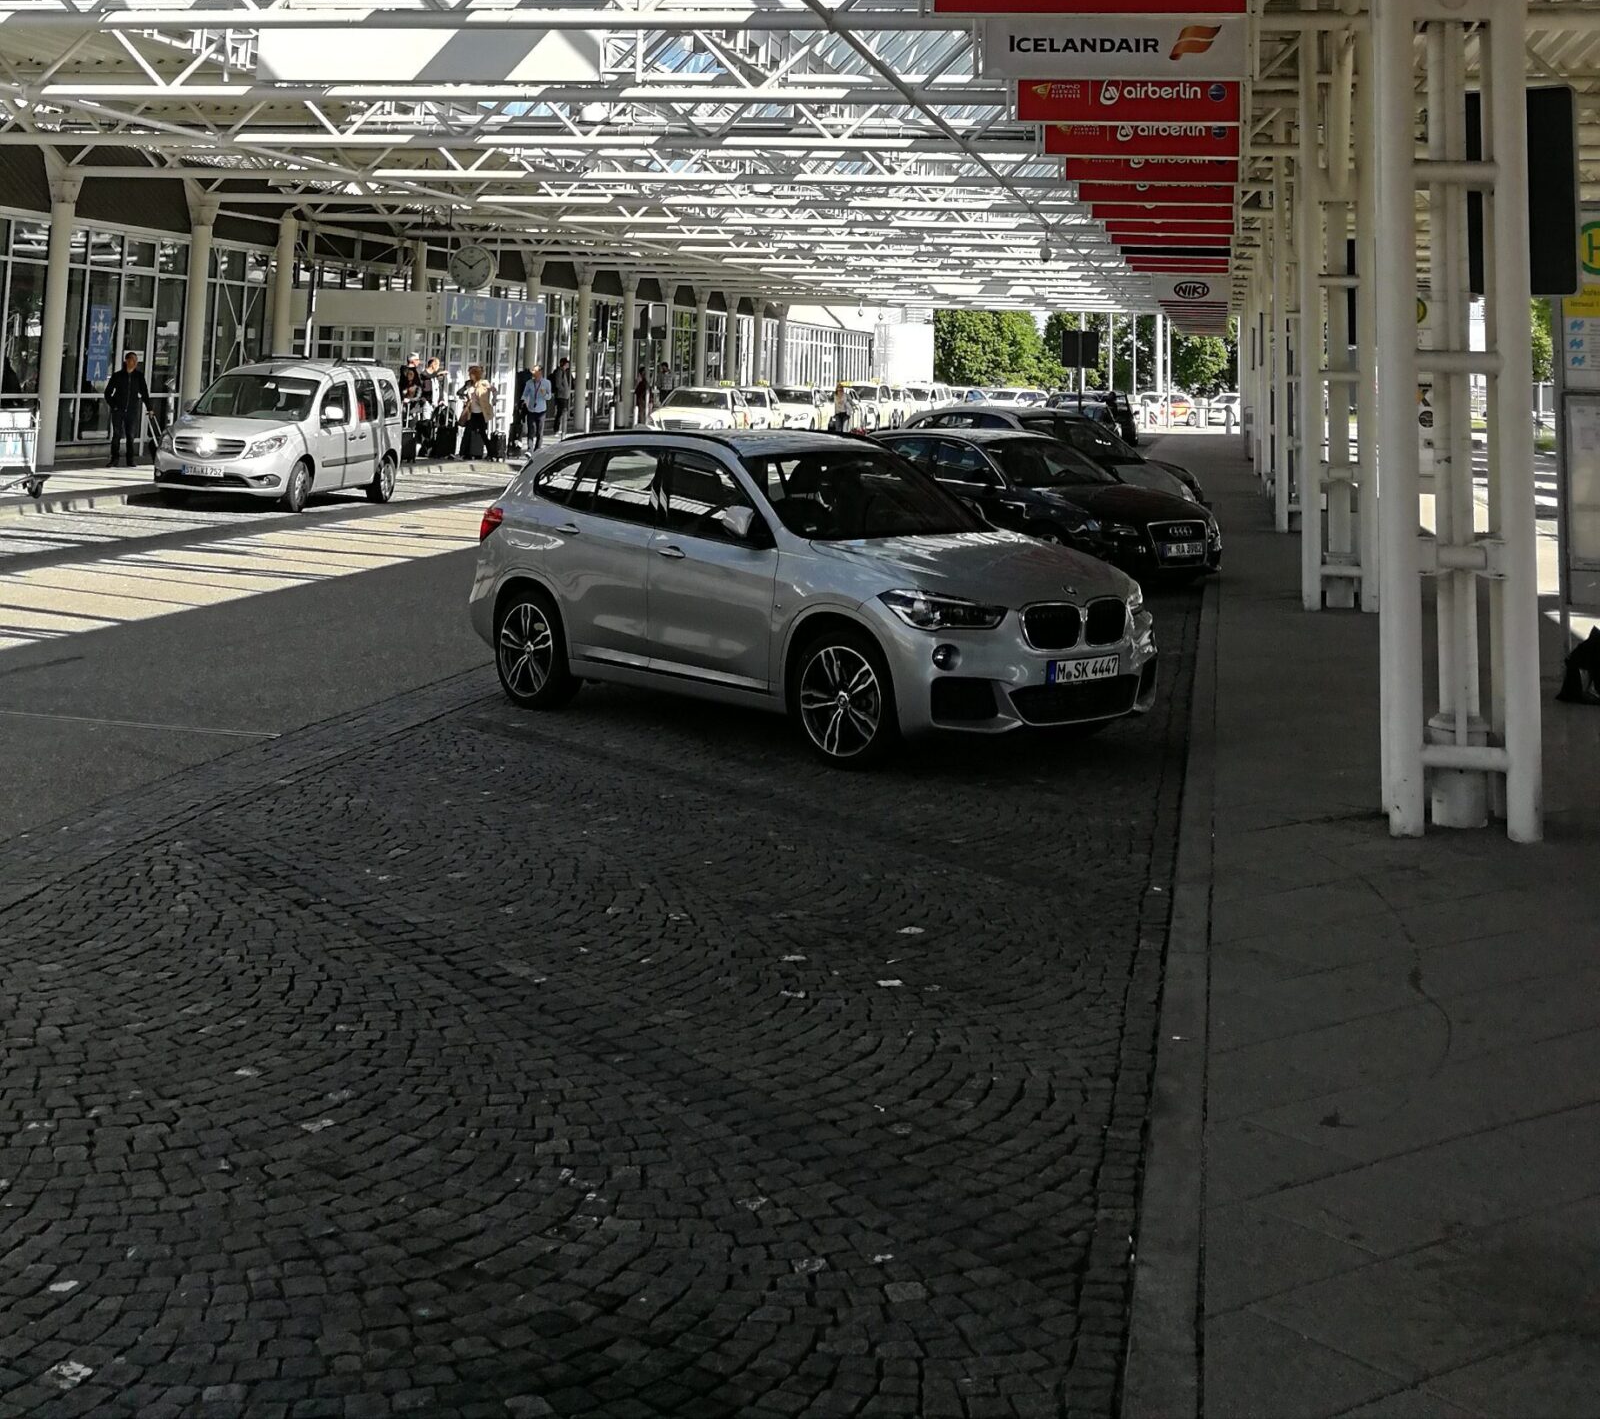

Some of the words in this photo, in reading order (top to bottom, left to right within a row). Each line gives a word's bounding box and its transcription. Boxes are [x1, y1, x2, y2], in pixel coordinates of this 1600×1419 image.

[1009, 35, 1160, 53] ICELANDAIR
[1123, 82, 1201, 99] airberlin
[1057, 663, 1066, 681] M
[1073, 661, 1090, 679] SK
[1091, 656, 1118, 677] 4447
